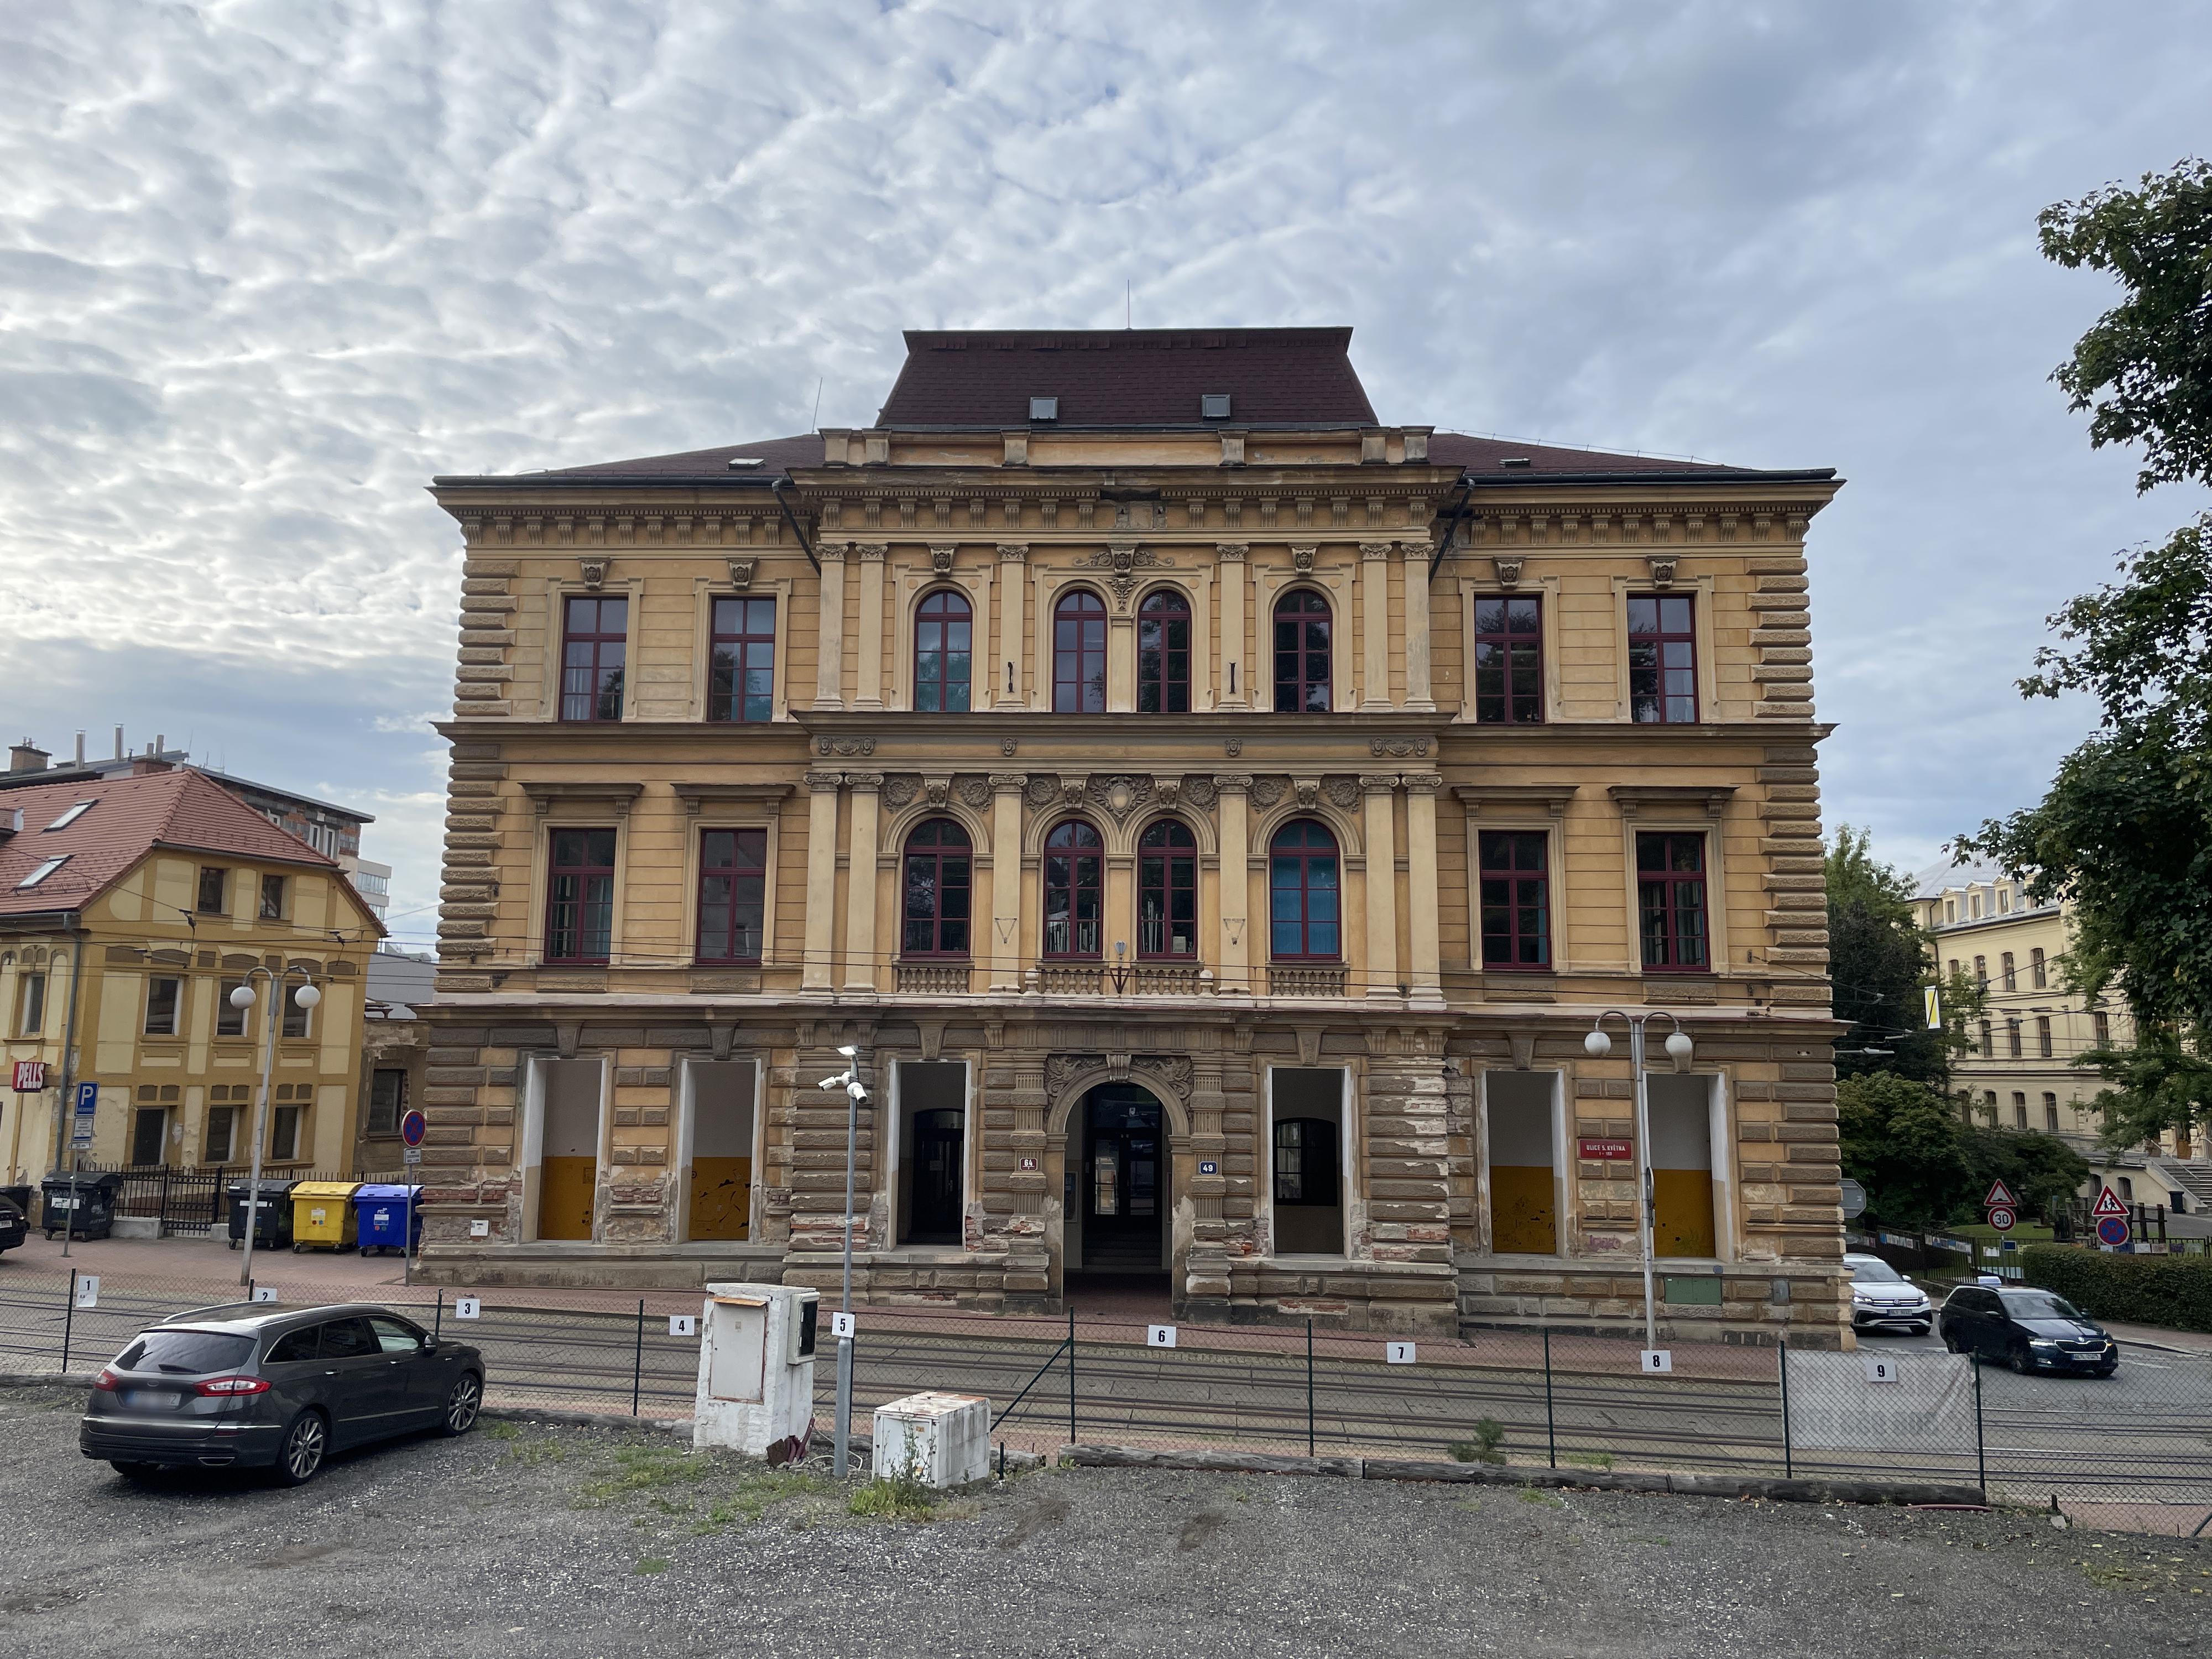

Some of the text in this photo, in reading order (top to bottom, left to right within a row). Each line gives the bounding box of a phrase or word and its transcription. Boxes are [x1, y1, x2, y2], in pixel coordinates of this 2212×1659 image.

[17, 1062, 44, 1088] PELLS
[81, 1086, 93, 1105] P
[1995, 1214, 2009, 1224] 30
[86, 1280, 90, 1290] 1
[465, 1303, 471, 1314] 3
[679, 1320, 685, 1332] 4
[840, 1318, 846, 1332] 5
[1158, 1330, 1166, 1342] 6
[1398, 1347, 1404, 1359] 7
[1652, 1355, 1660, 1367] 8
[1877, 1365, 1885, 1377] 9
